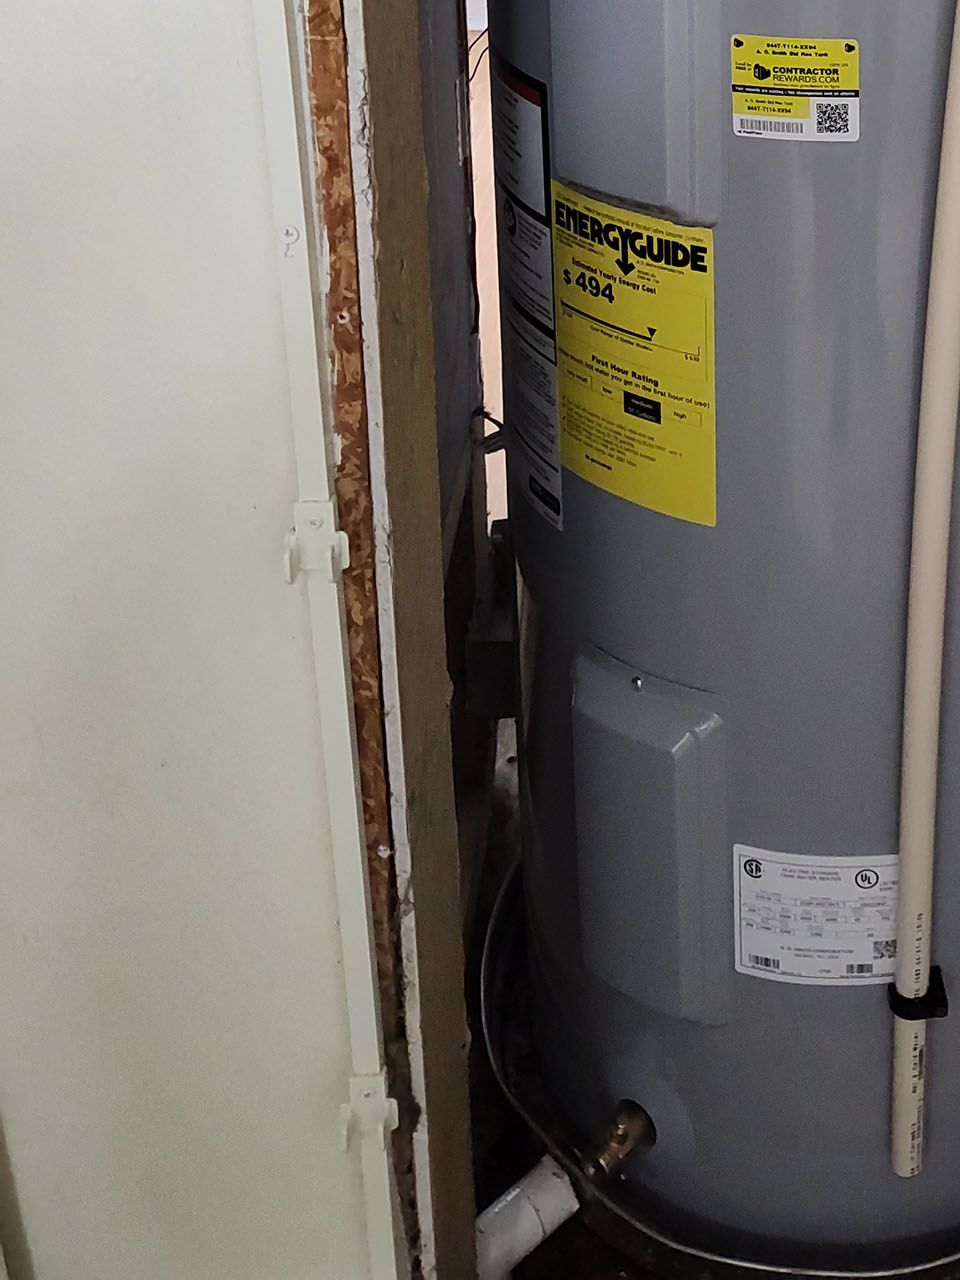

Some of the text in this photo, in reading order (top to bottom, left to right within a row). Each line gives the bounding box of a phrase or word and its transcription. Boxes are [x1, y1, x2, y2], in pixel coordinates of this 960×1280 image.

[772, 66, 839, 76] CONTRACTOR
[773, 74, 840, 84] REWARDS.COM
[555, 199, 708, 275] ENERGYGUIDE
[563, 269, 572, 286] $
[576, 272, 615, 304] 494
[599, 269, 617, 284] Yearly
[619, 277, 640, 291] Energy
[641, 285, 656, 295] Cost
[592, 355, 659, 388] First Hour Rating
[611, 375, 622, 383] you
[624, 378, 633, 386] get
[642, 384, 652, 393] the
[654, 388, 666, 398] first
[668, 392, 684, 402] hour
[673, 411, 687, 420] high
